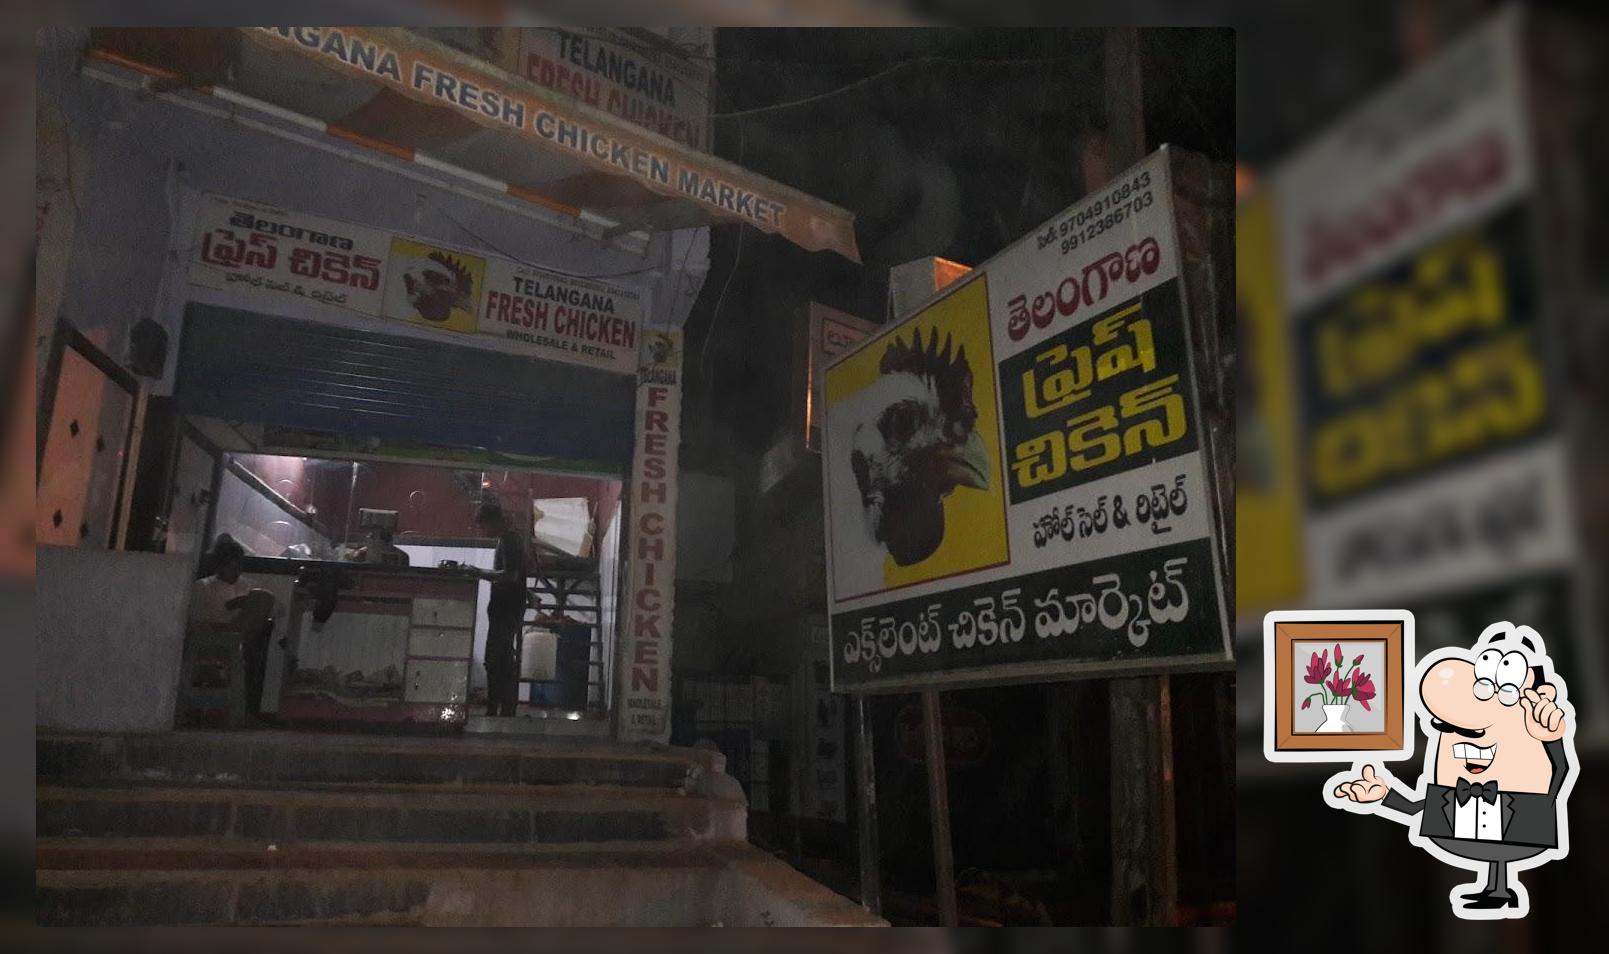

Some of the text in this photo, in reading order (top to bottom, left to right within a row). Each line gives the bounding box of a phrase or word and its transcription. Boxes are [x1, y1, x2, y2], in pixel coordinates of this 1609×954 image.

[558, 31, 676, 106] TELANGANA
[413, 62, 525, 128] FRESH
[535, 112, 670, 184] CHICKEN
[678, 170, 788, 226] MARKET
[1059, 171, 1151, 239] 9704910843
[1061, 191, 1153, 256] 9912386703
[288, 247, 382, 291] చికెన్
[513, 275, 615, 314] TELANGANA
[1007, 236, 1160, 342] తెలంగాణ
[486, 290, 636, 349] FRESH CHICKEN
[506, 329, 617, 361] WHOLESALE & RETAIL
[1011, 374, 1189, 489] చికెన్
[631, 387, 670, 693] FRESH CHICKEN
[1113, 495, 1132, 529] &
[947, 587, 1027, 650] చికెన్
[1034, 557, 1190, 648] మార్కెట్
